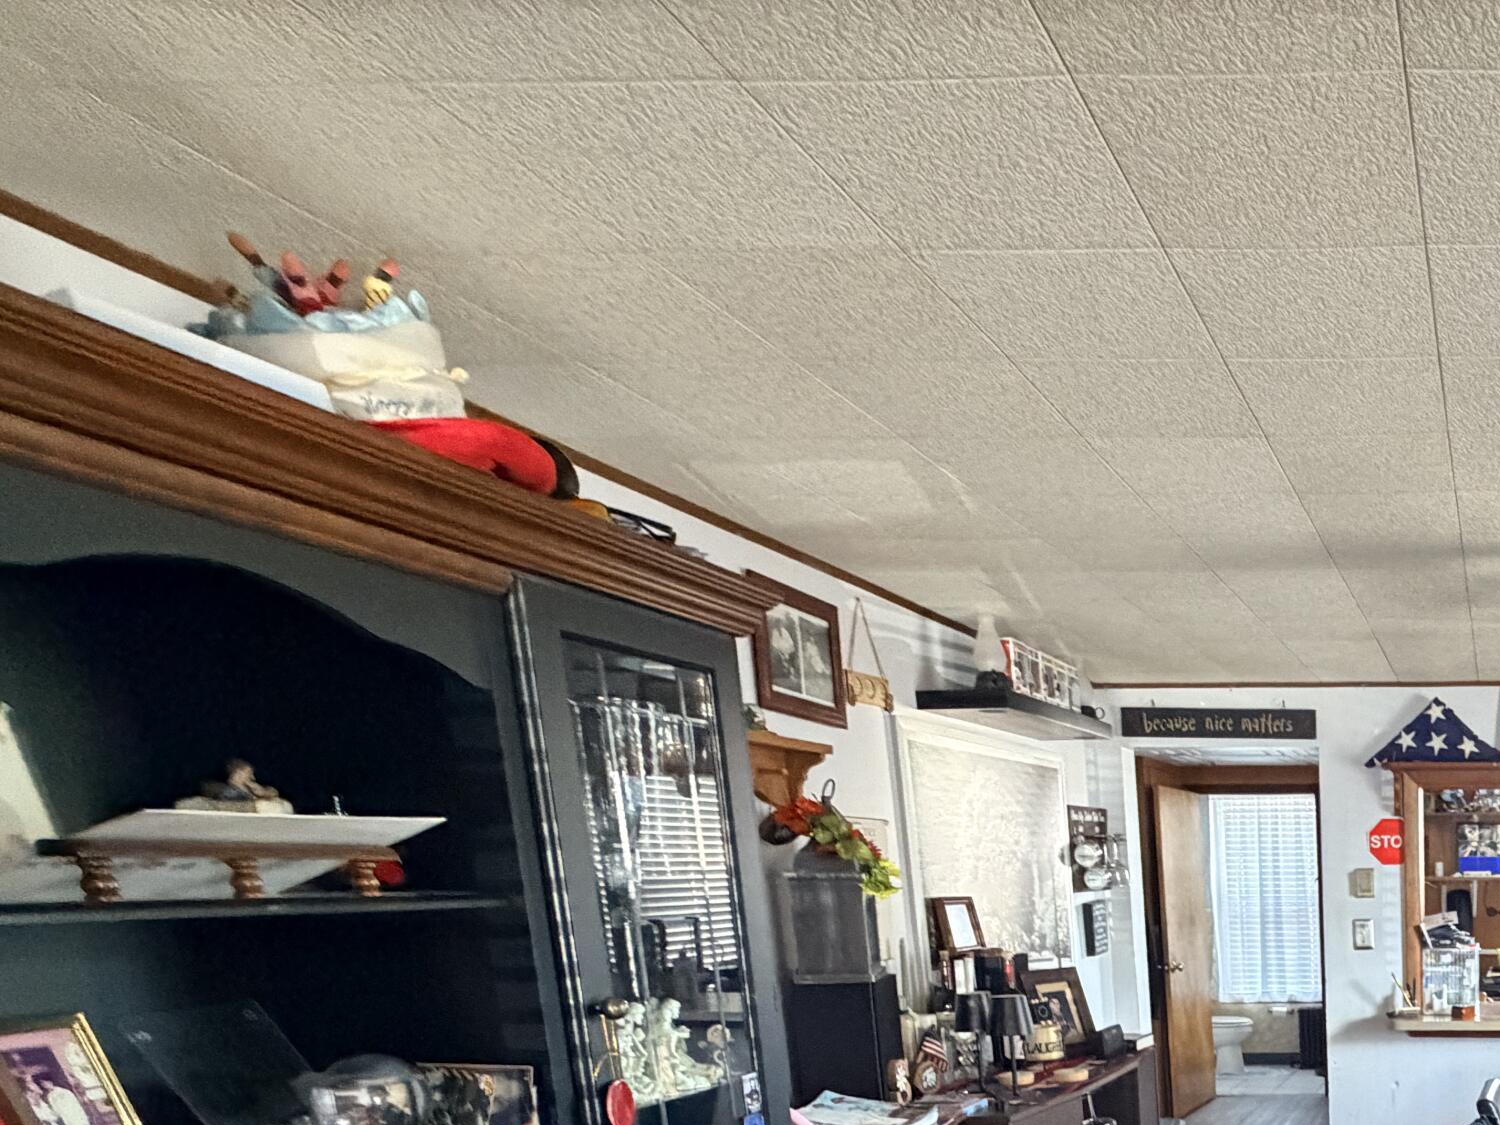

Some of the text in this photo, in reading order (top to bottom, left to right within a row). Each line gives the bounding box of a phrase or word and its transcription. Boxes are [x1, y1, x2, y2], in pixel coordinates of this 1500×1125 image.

[1143, 712, 1294, 734] because nice matters
[1370, 835, 1403, 848] STO
